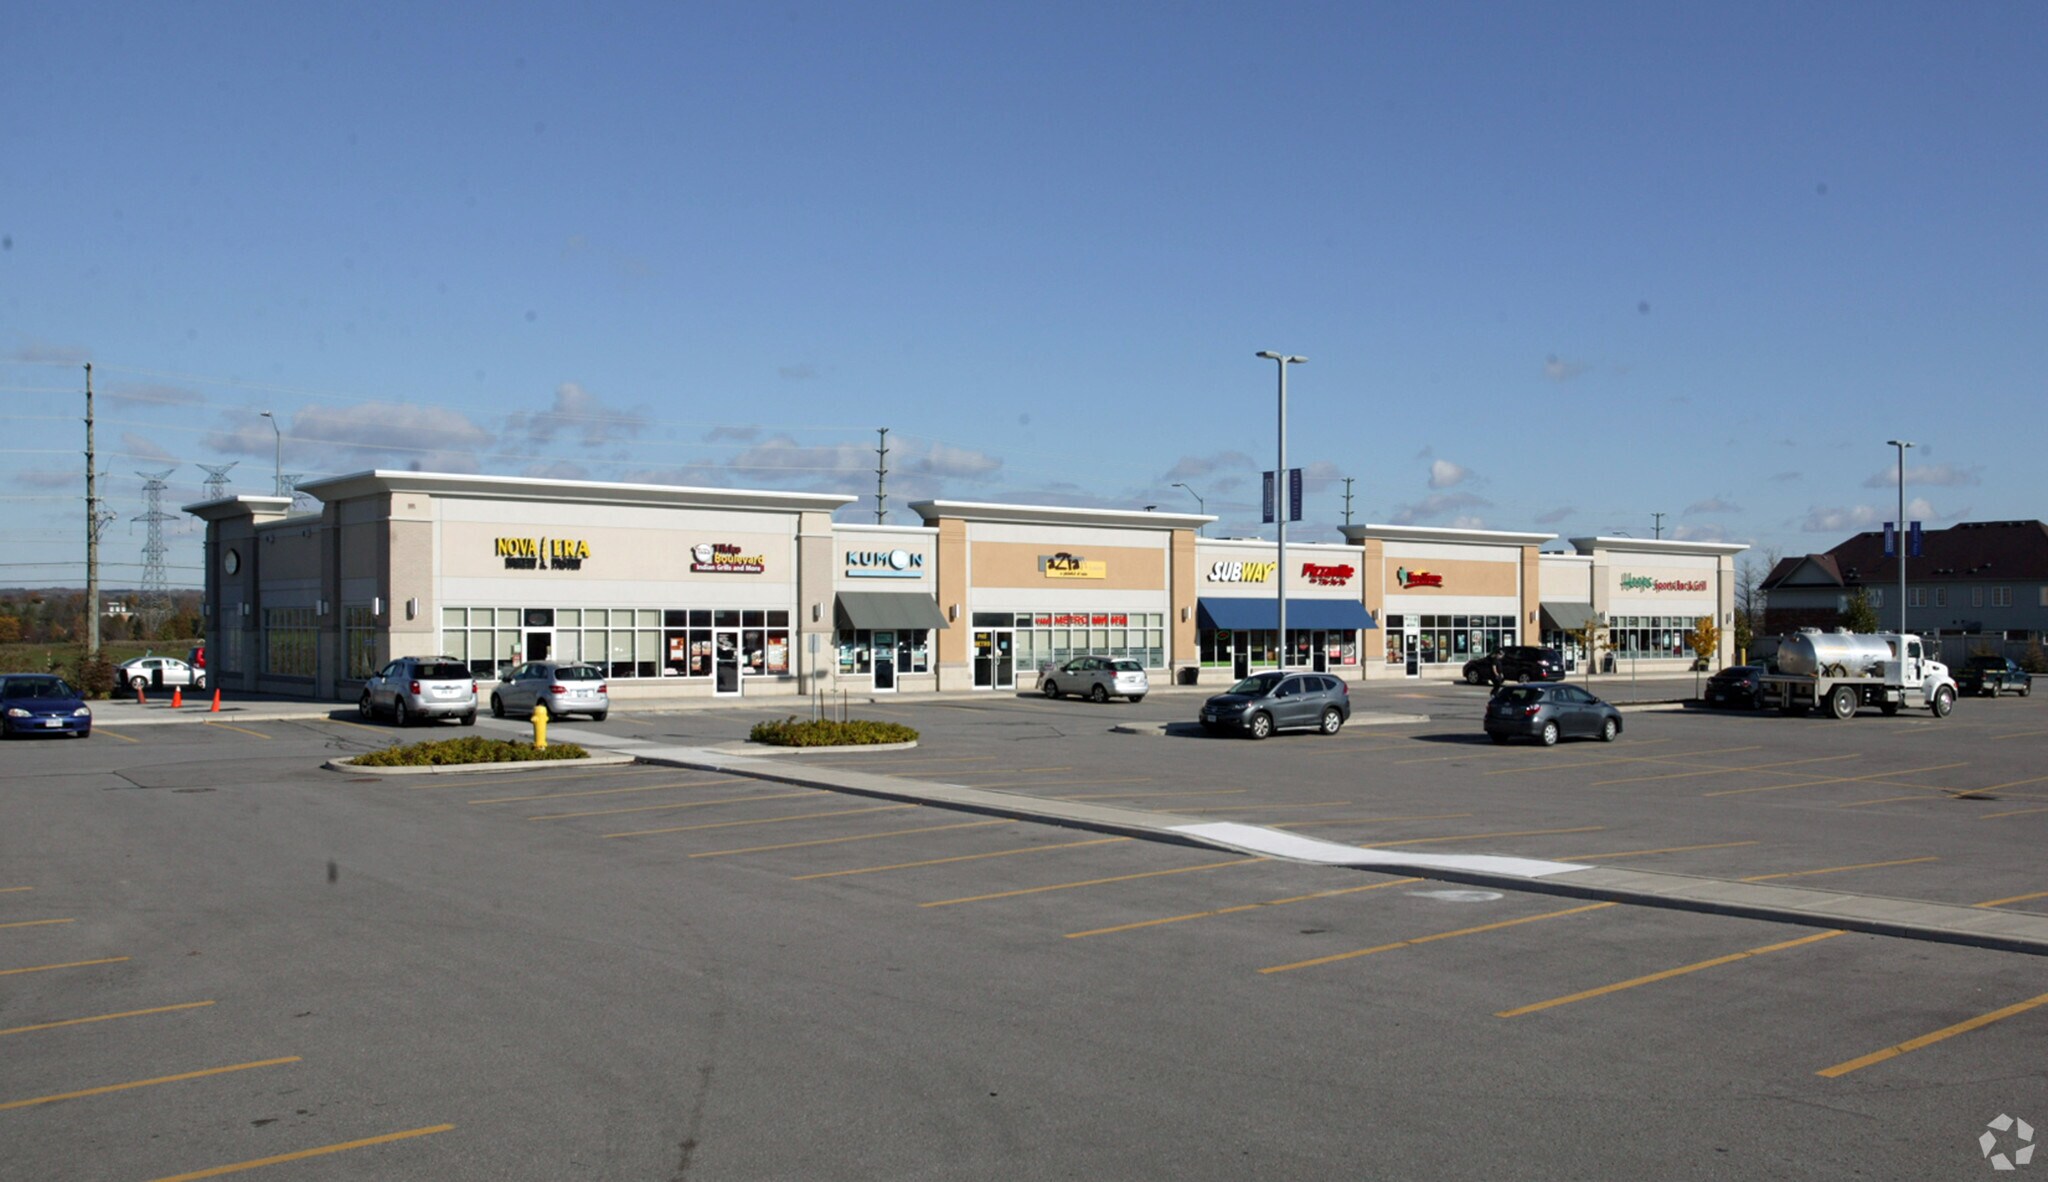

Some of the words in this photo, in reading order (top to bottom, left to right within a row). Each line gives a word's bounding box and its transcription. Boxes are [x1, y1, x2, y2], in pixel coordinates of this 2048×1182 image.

[495, 537, 538, 557] NOVA
[551, 539, 591, 559] ERA
[713, 552, 765, 565] Boulevard
[846, 549, 924, 571] KUMON
[1208, 561, 1277, 583] SUBWAY
